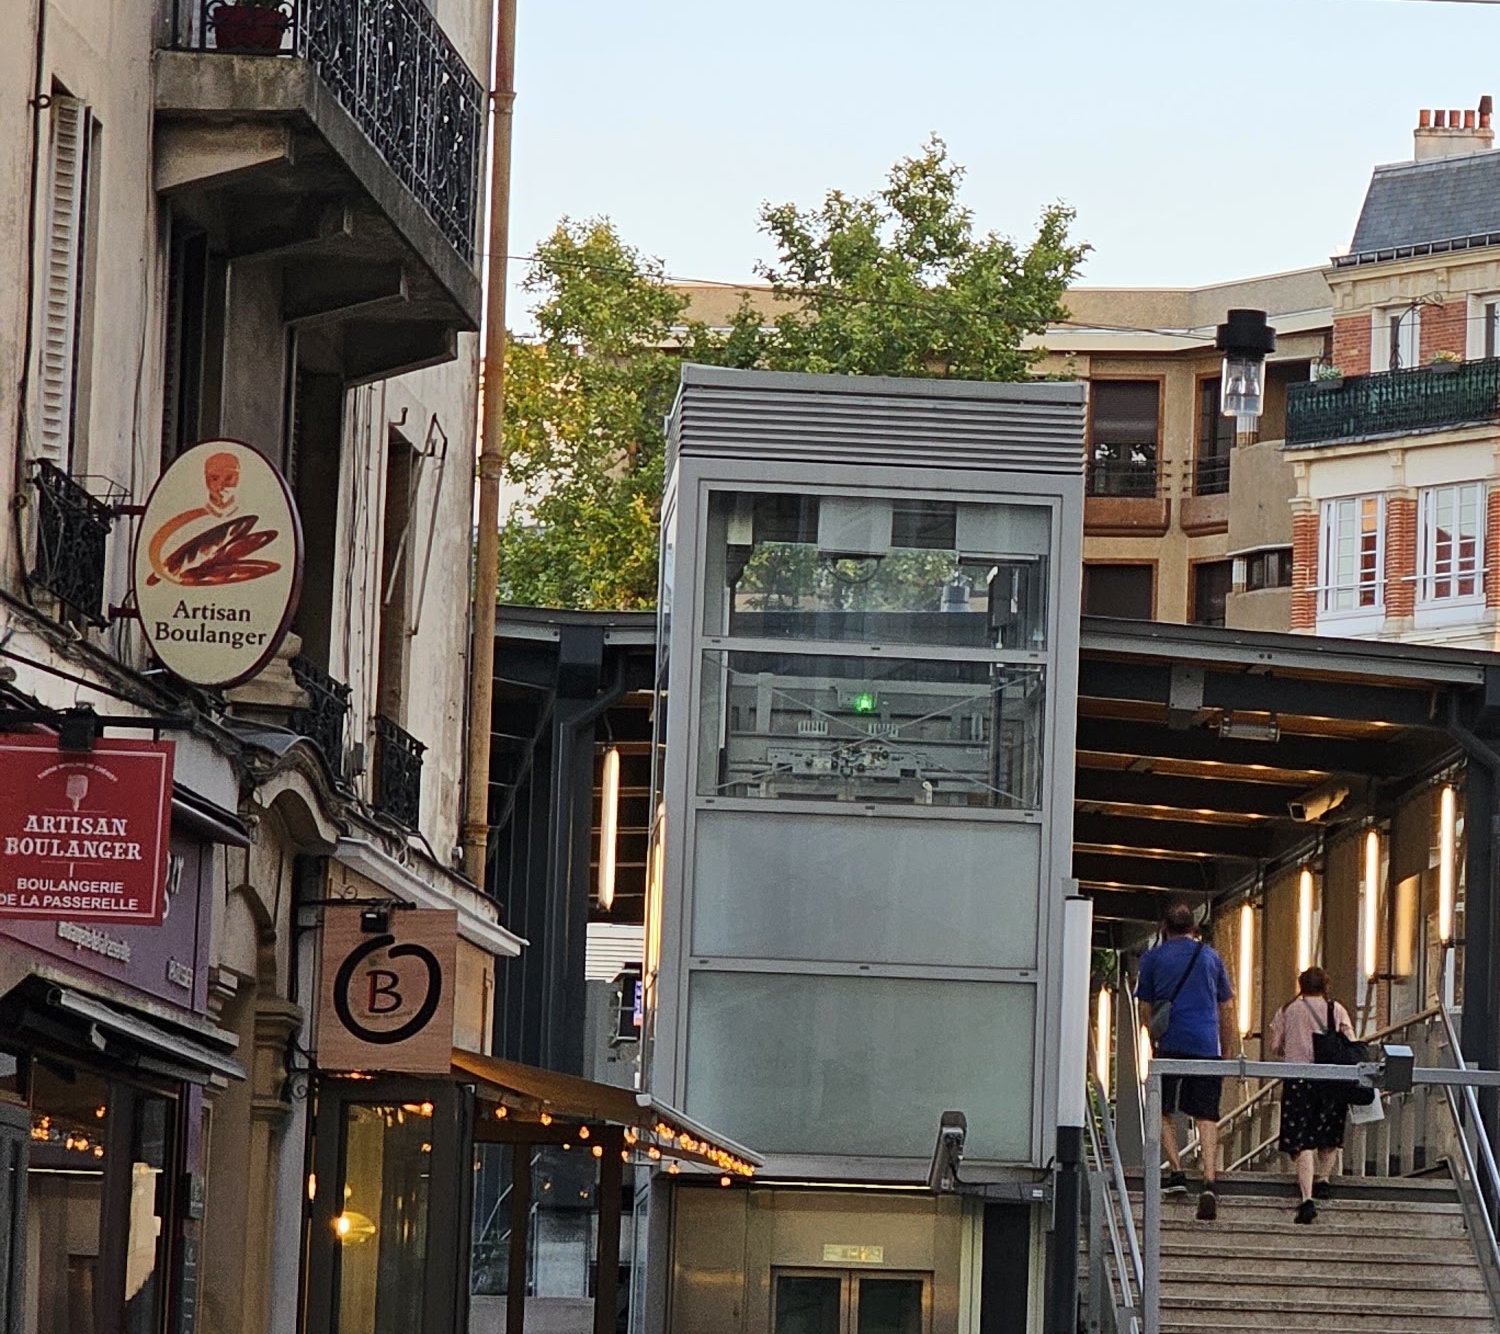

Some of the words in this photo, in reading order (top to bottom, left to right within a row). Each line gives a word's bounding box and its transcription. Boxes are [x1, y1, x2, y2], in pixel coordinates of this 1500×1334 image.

[172, 599, 251, 622] Artisan
[155, 621, 267, 650] Boulanger
[23, 814, 128, 837] ARTISAN
[4, 837, 142, 861] BOULANGER
[17, 877, 124, 895] BOULANGERIE
[20, 894, 40, 907] LA
[43, 895, 139, 911] PASSERELLE
[366, 969, 403, 1014] B
